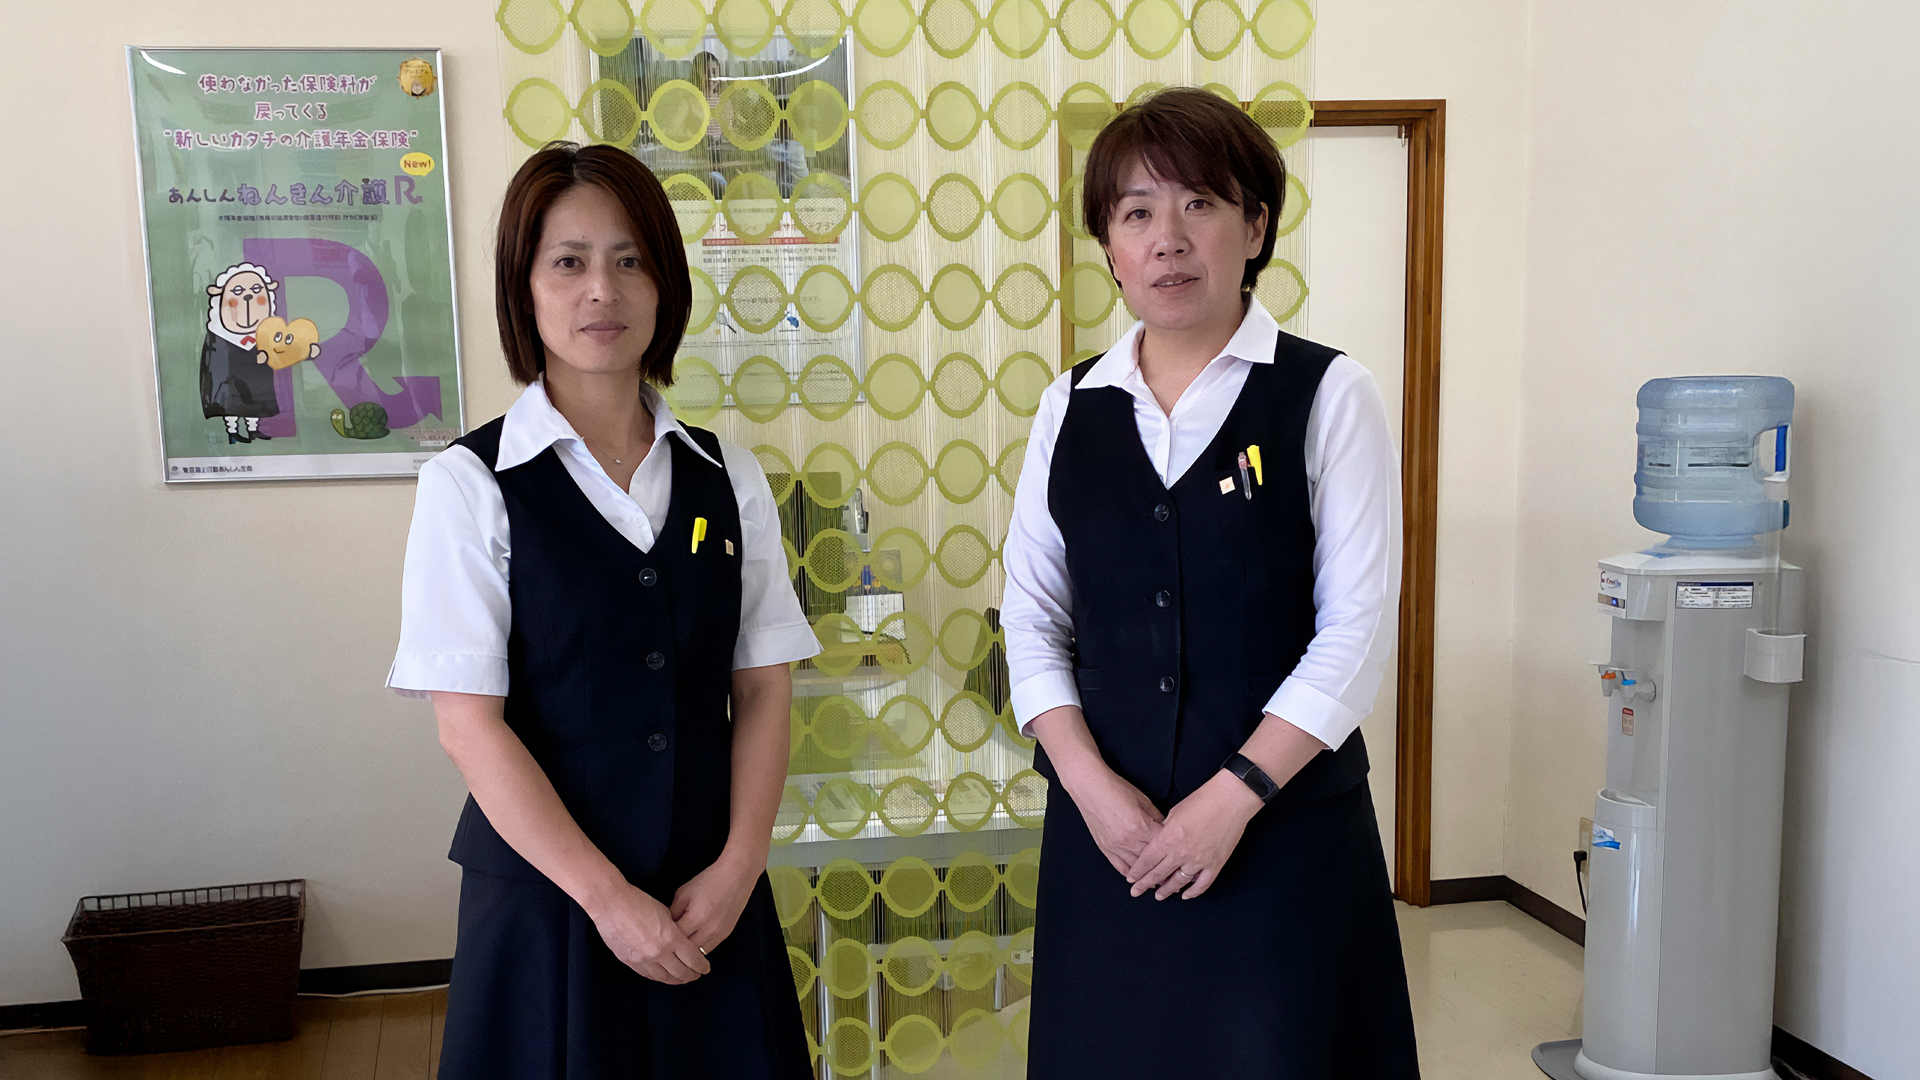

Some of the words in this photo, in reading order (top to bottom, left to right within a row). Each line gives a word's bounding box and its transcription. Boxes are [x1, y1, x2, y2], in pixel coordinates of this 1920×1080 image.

[199, 74, 376, 94] 使わなかった保険料が
[254, 102, 327, 120] 戻ってくる
[403, 159, 431, 168] New!
[169, 175, 423, 206] あんしんねんきん介護R
